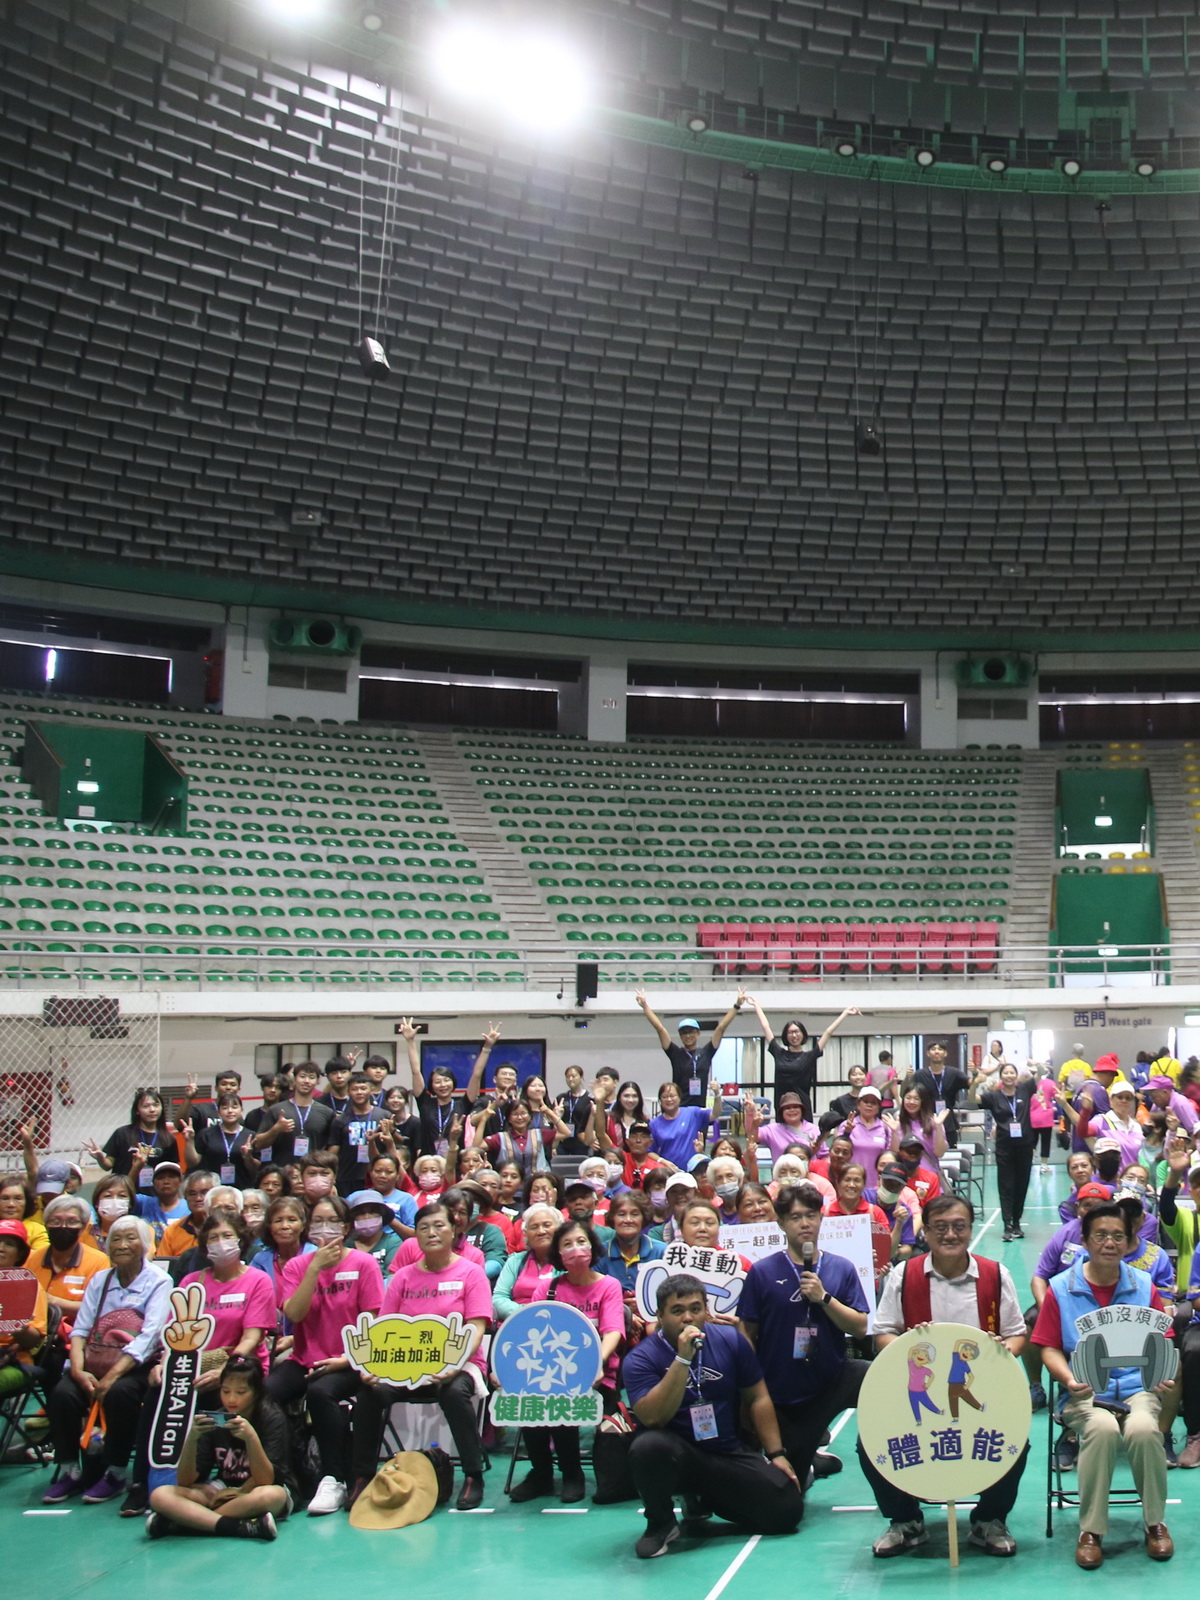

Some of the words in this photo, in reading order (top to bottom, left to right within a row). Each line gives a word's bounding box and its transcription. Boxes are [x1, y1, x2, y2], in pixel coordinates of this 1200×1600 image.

[1074, 1011, 1106, 1027] 西門
[1108, 1017, 1130, 1026] West
[1133, 1017, 1152, 1028] gate
[721, 1234, 787, 1249] 活一起趣】
[666, 1245, 738, 1277] 我運動
[1076, 1306, 1172, 1335] 運動沒煩惱
[373, 1347, 441, 1364] 加油加油
[493, 1394, 598, 1421] 健康快樂
[887, 1427, 1006, 1471] 體適能
